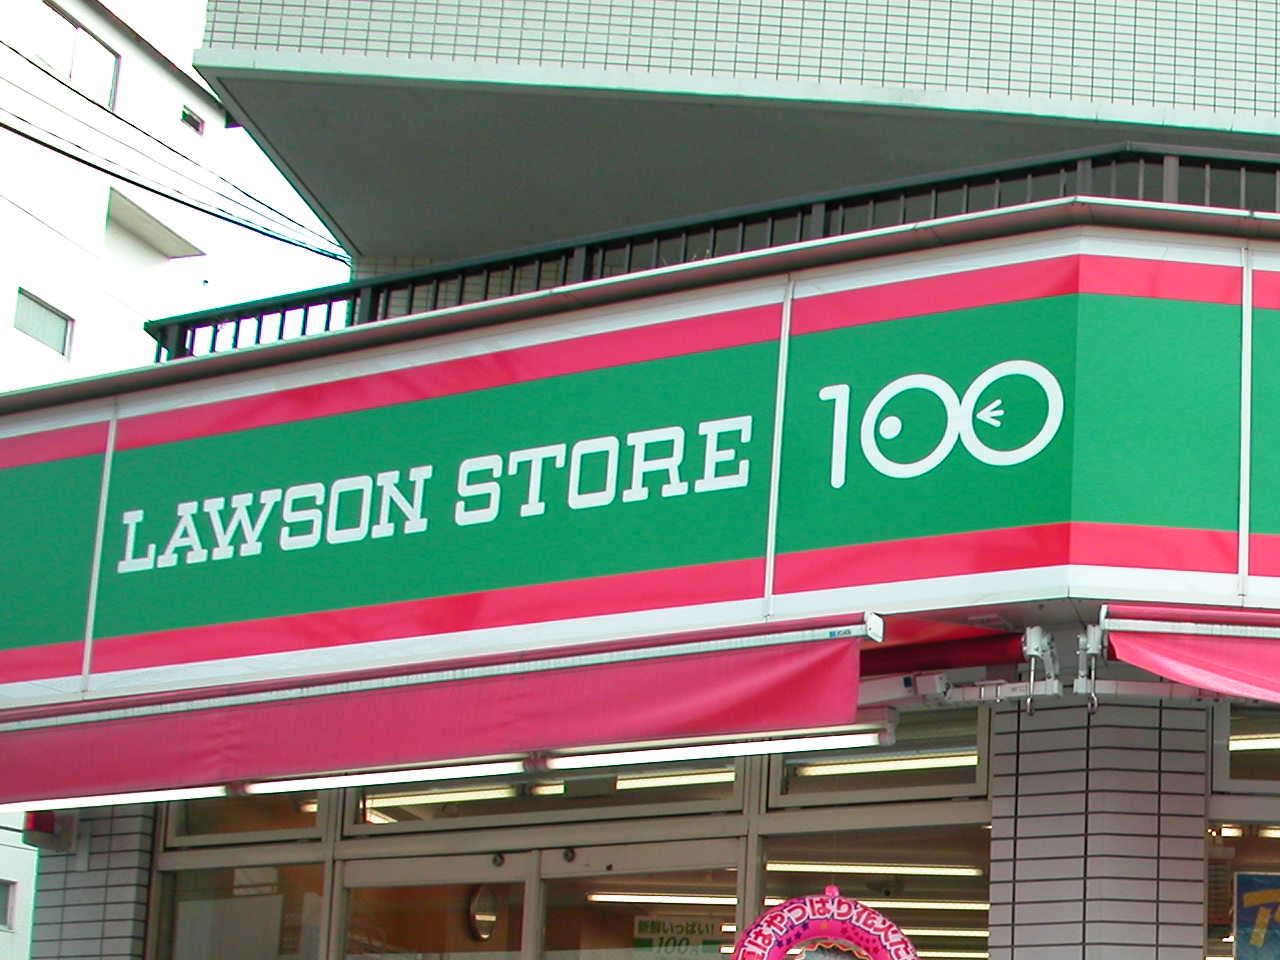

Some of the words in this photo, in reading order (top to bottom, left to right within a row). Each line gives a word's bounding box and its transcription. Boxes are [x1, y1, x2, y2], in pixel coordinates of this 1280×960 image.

[116, 464, 434, 573] LAWSON
[453, 414, 754, 527] STORE
[818, 360, 1066, 489] 100
